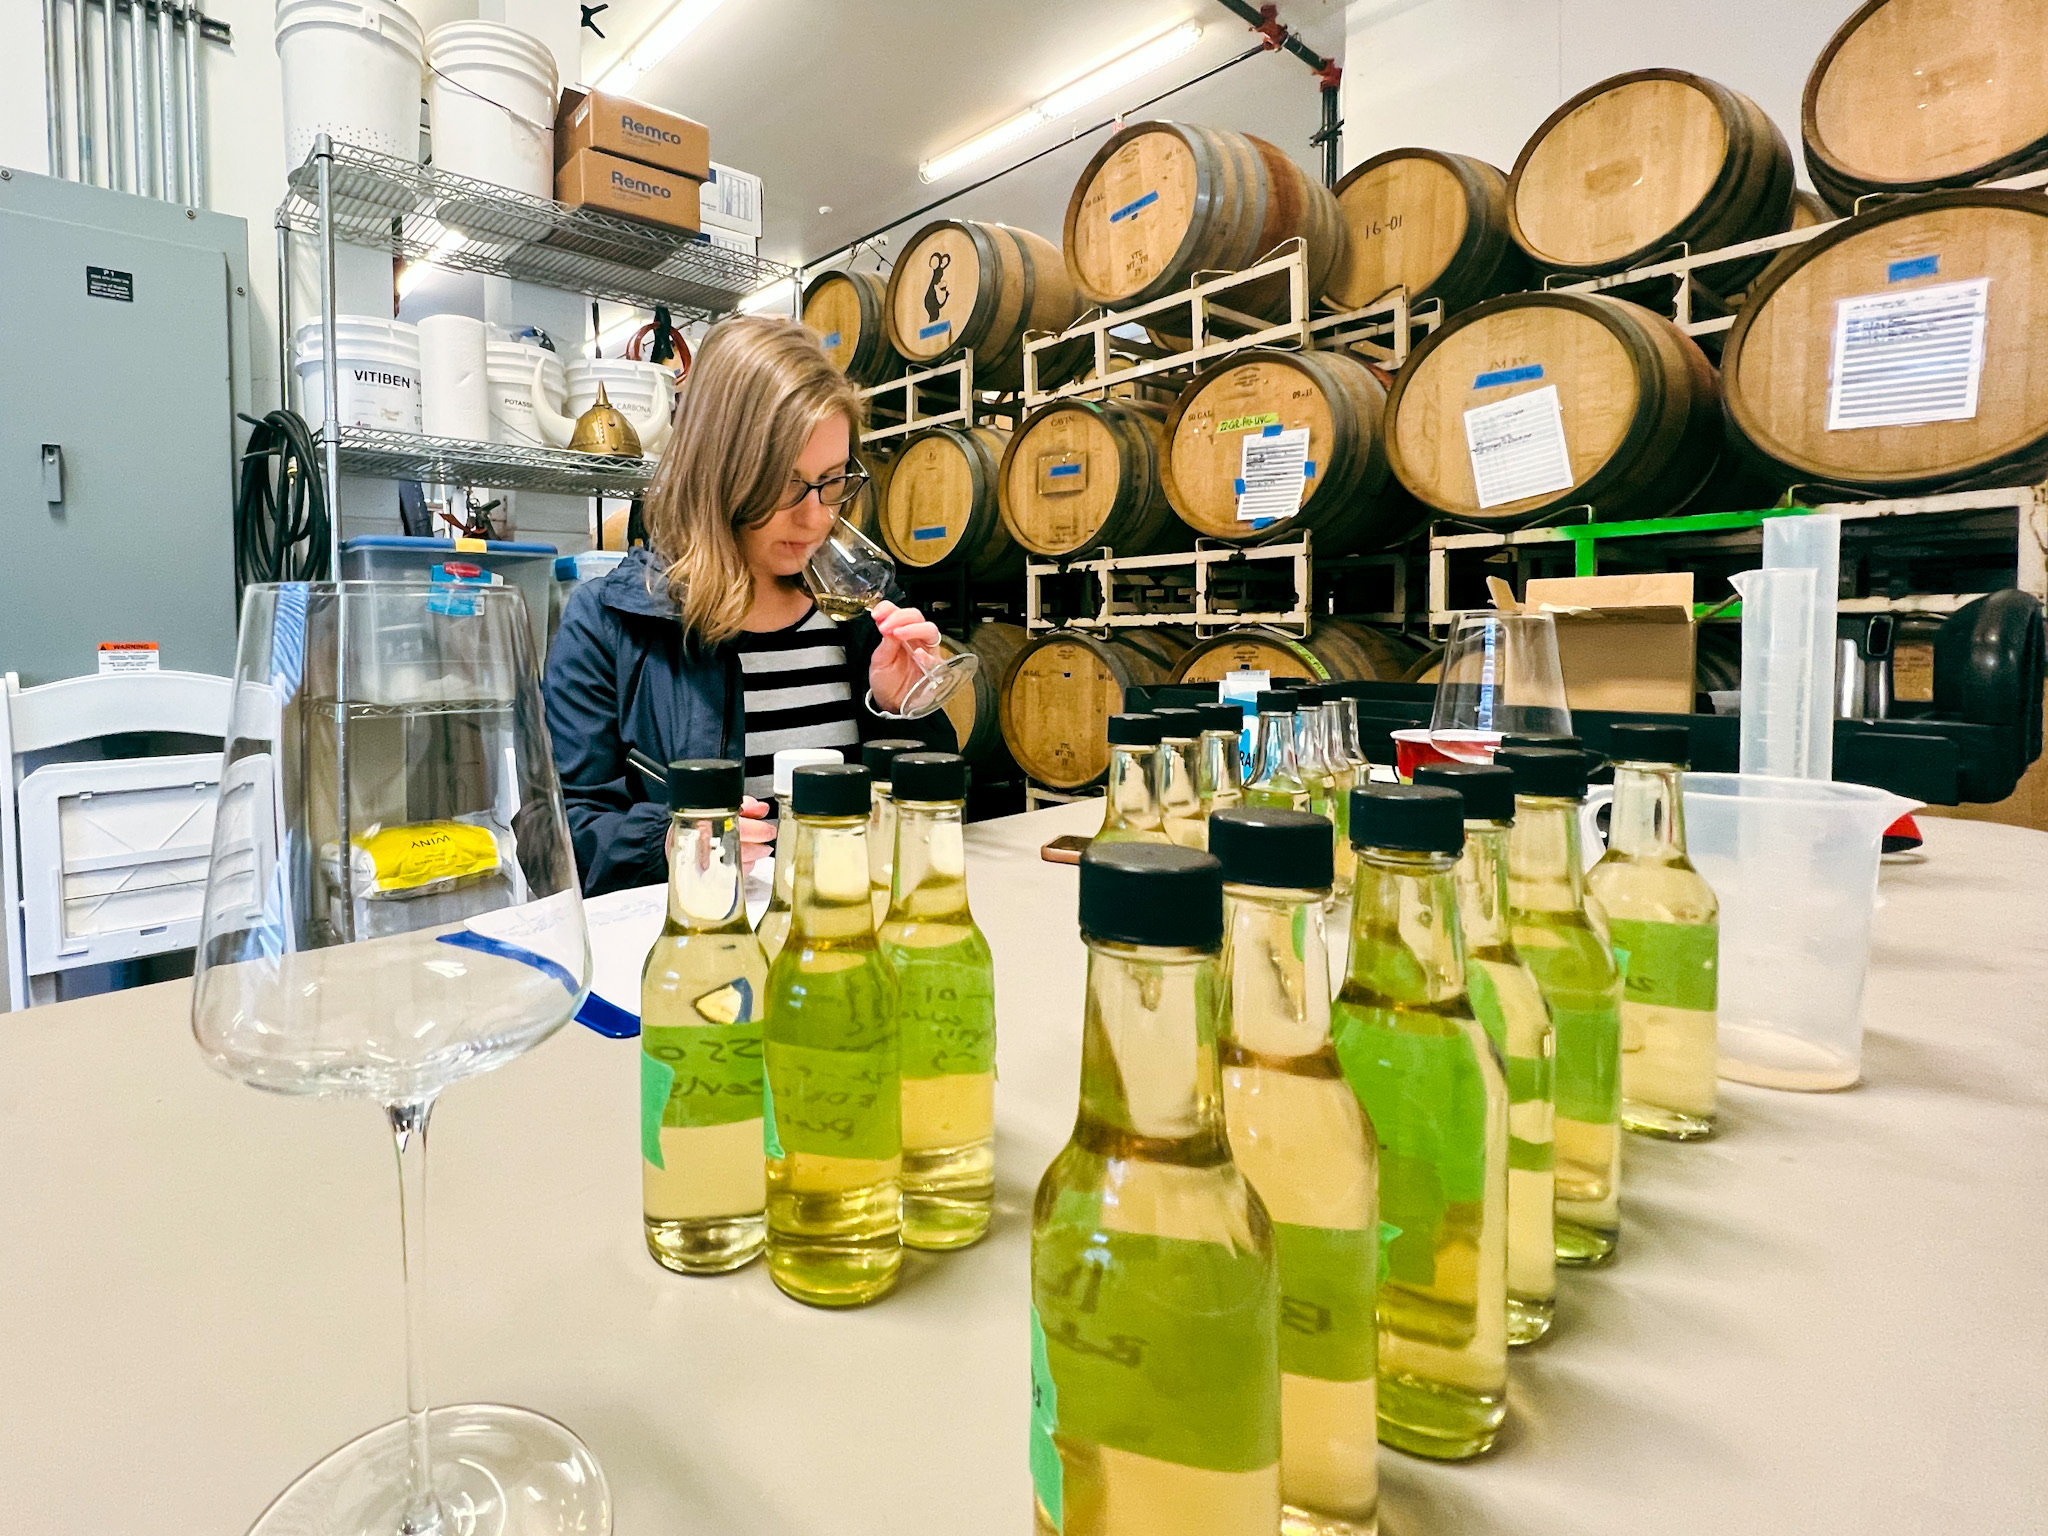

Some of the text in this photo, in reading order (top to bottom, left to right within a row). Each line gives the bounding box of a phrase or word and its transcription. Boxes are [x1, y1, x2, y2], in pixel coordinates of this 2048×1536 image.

[621, 115, 681, 146] Remco
[611, 170, 671, 199] Remco
[354, 370, 410, 389] VITIBEN
[411, 835, 451, 849] WINY
